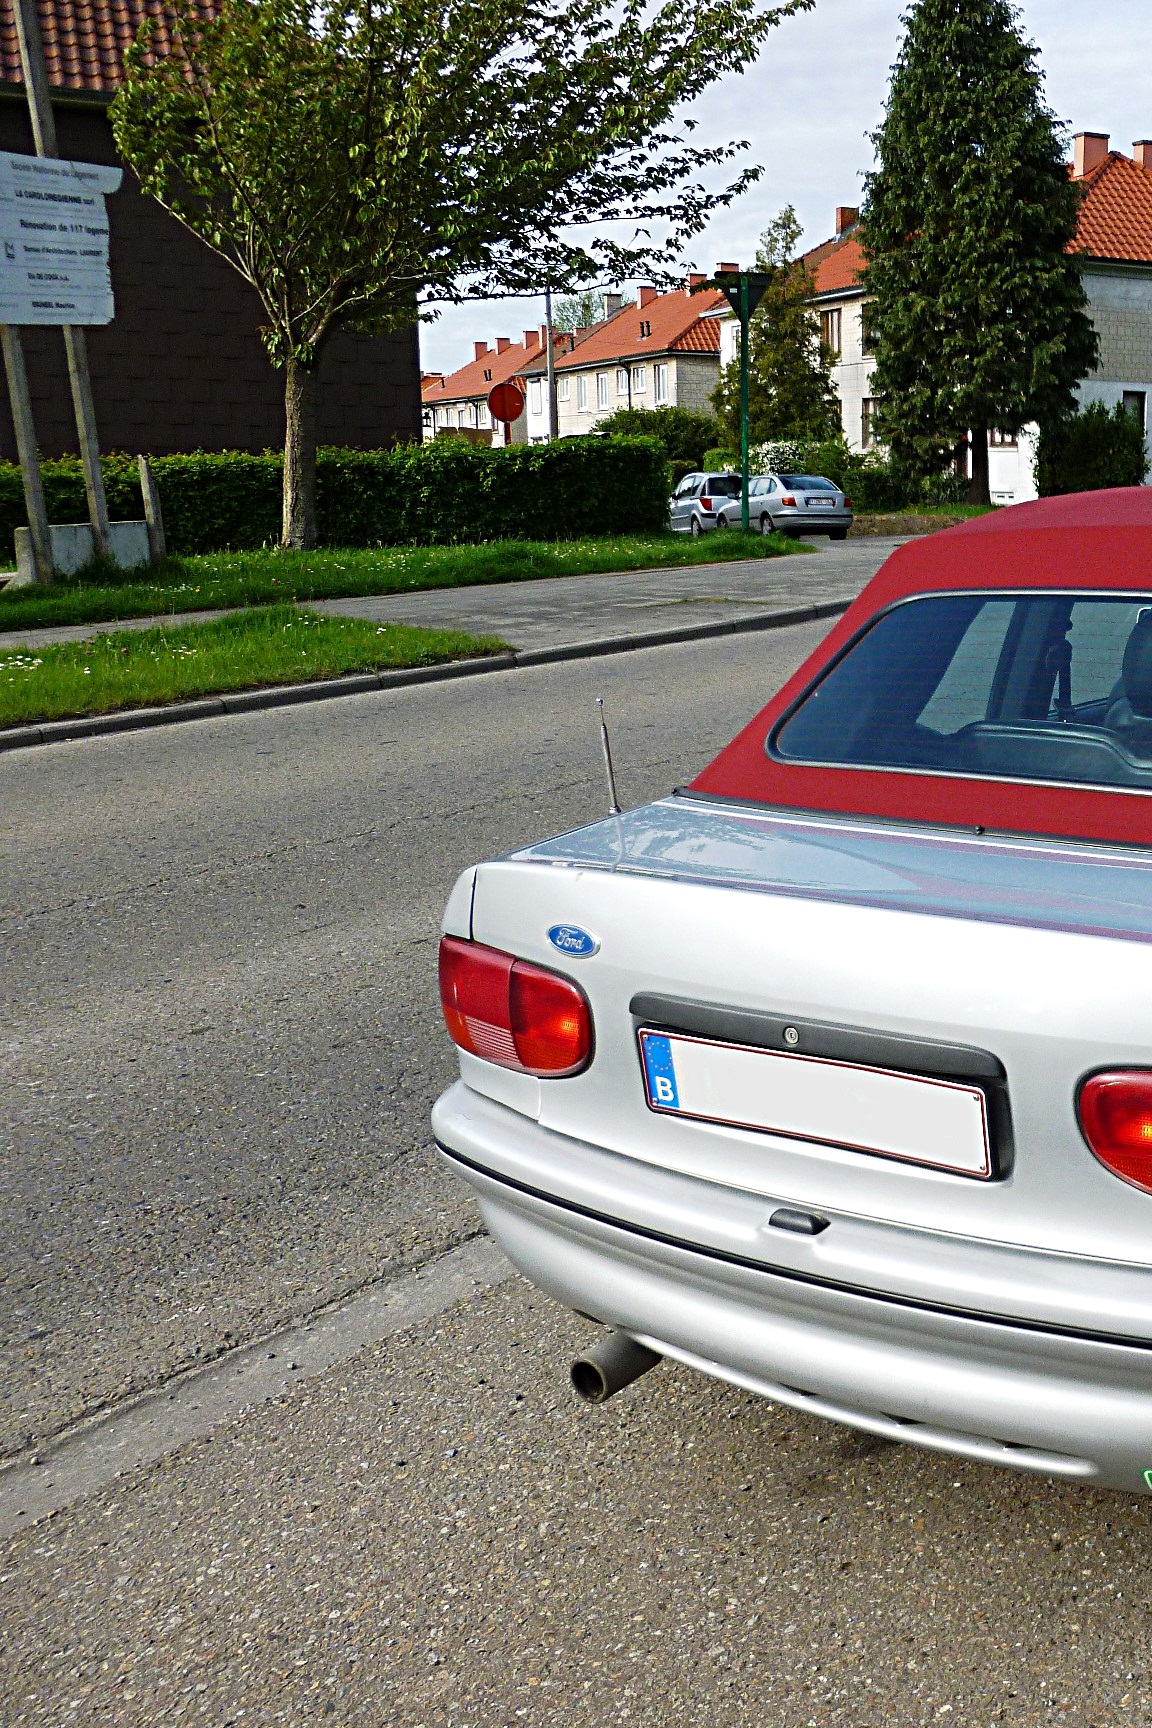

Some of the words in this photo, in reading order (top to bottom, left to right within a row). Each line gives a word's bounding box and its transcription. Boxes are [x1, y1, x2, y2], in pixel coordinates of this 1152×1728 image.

[15, 189, 23, 197] LA
[58, 224, 68, 232] de
[70, 224, 83, 233] 117
[556, 927, 586, 950] Ford
[655, 1075, 675, 1102] B
